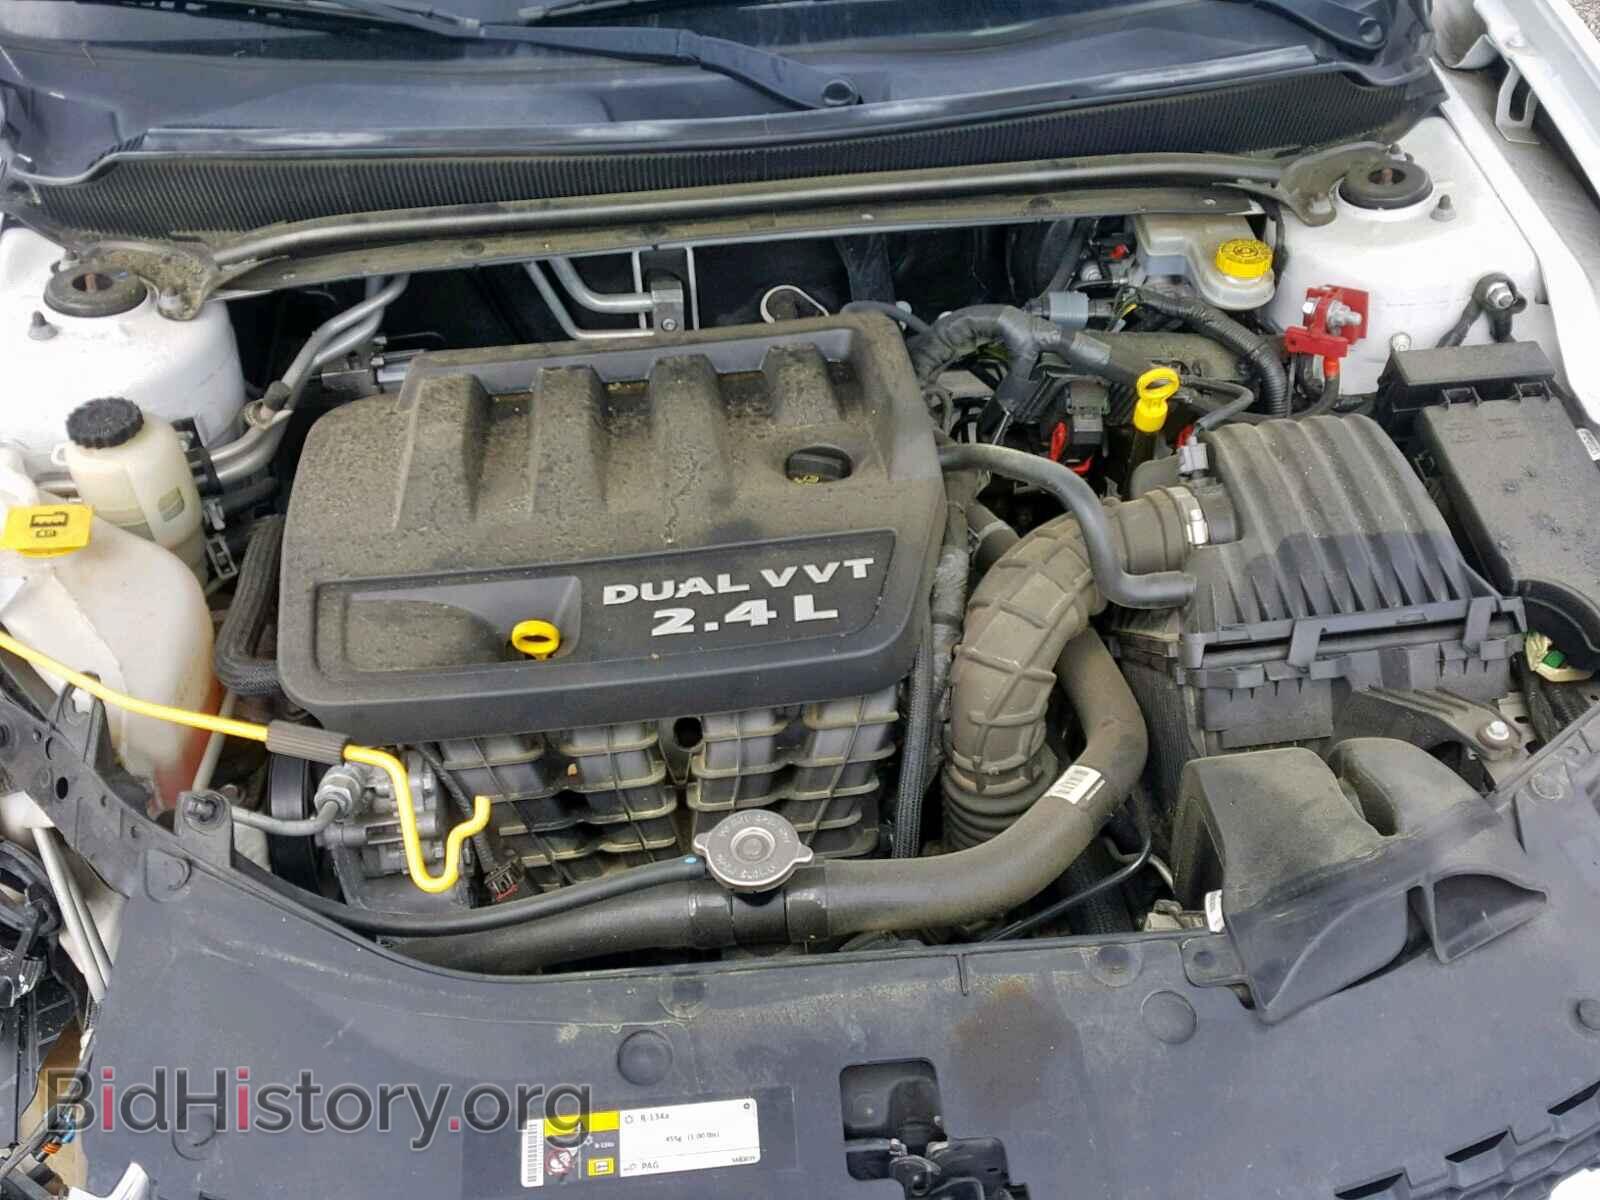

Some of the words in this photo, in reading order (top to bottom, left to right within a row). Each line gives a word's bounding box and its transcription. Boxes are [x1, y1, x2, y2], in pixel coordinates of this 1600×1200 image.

[603, 573, 751, 605] DUAL
[760, 557, 875, 588] VVT
[651, 599, 778, 637] 2.4
